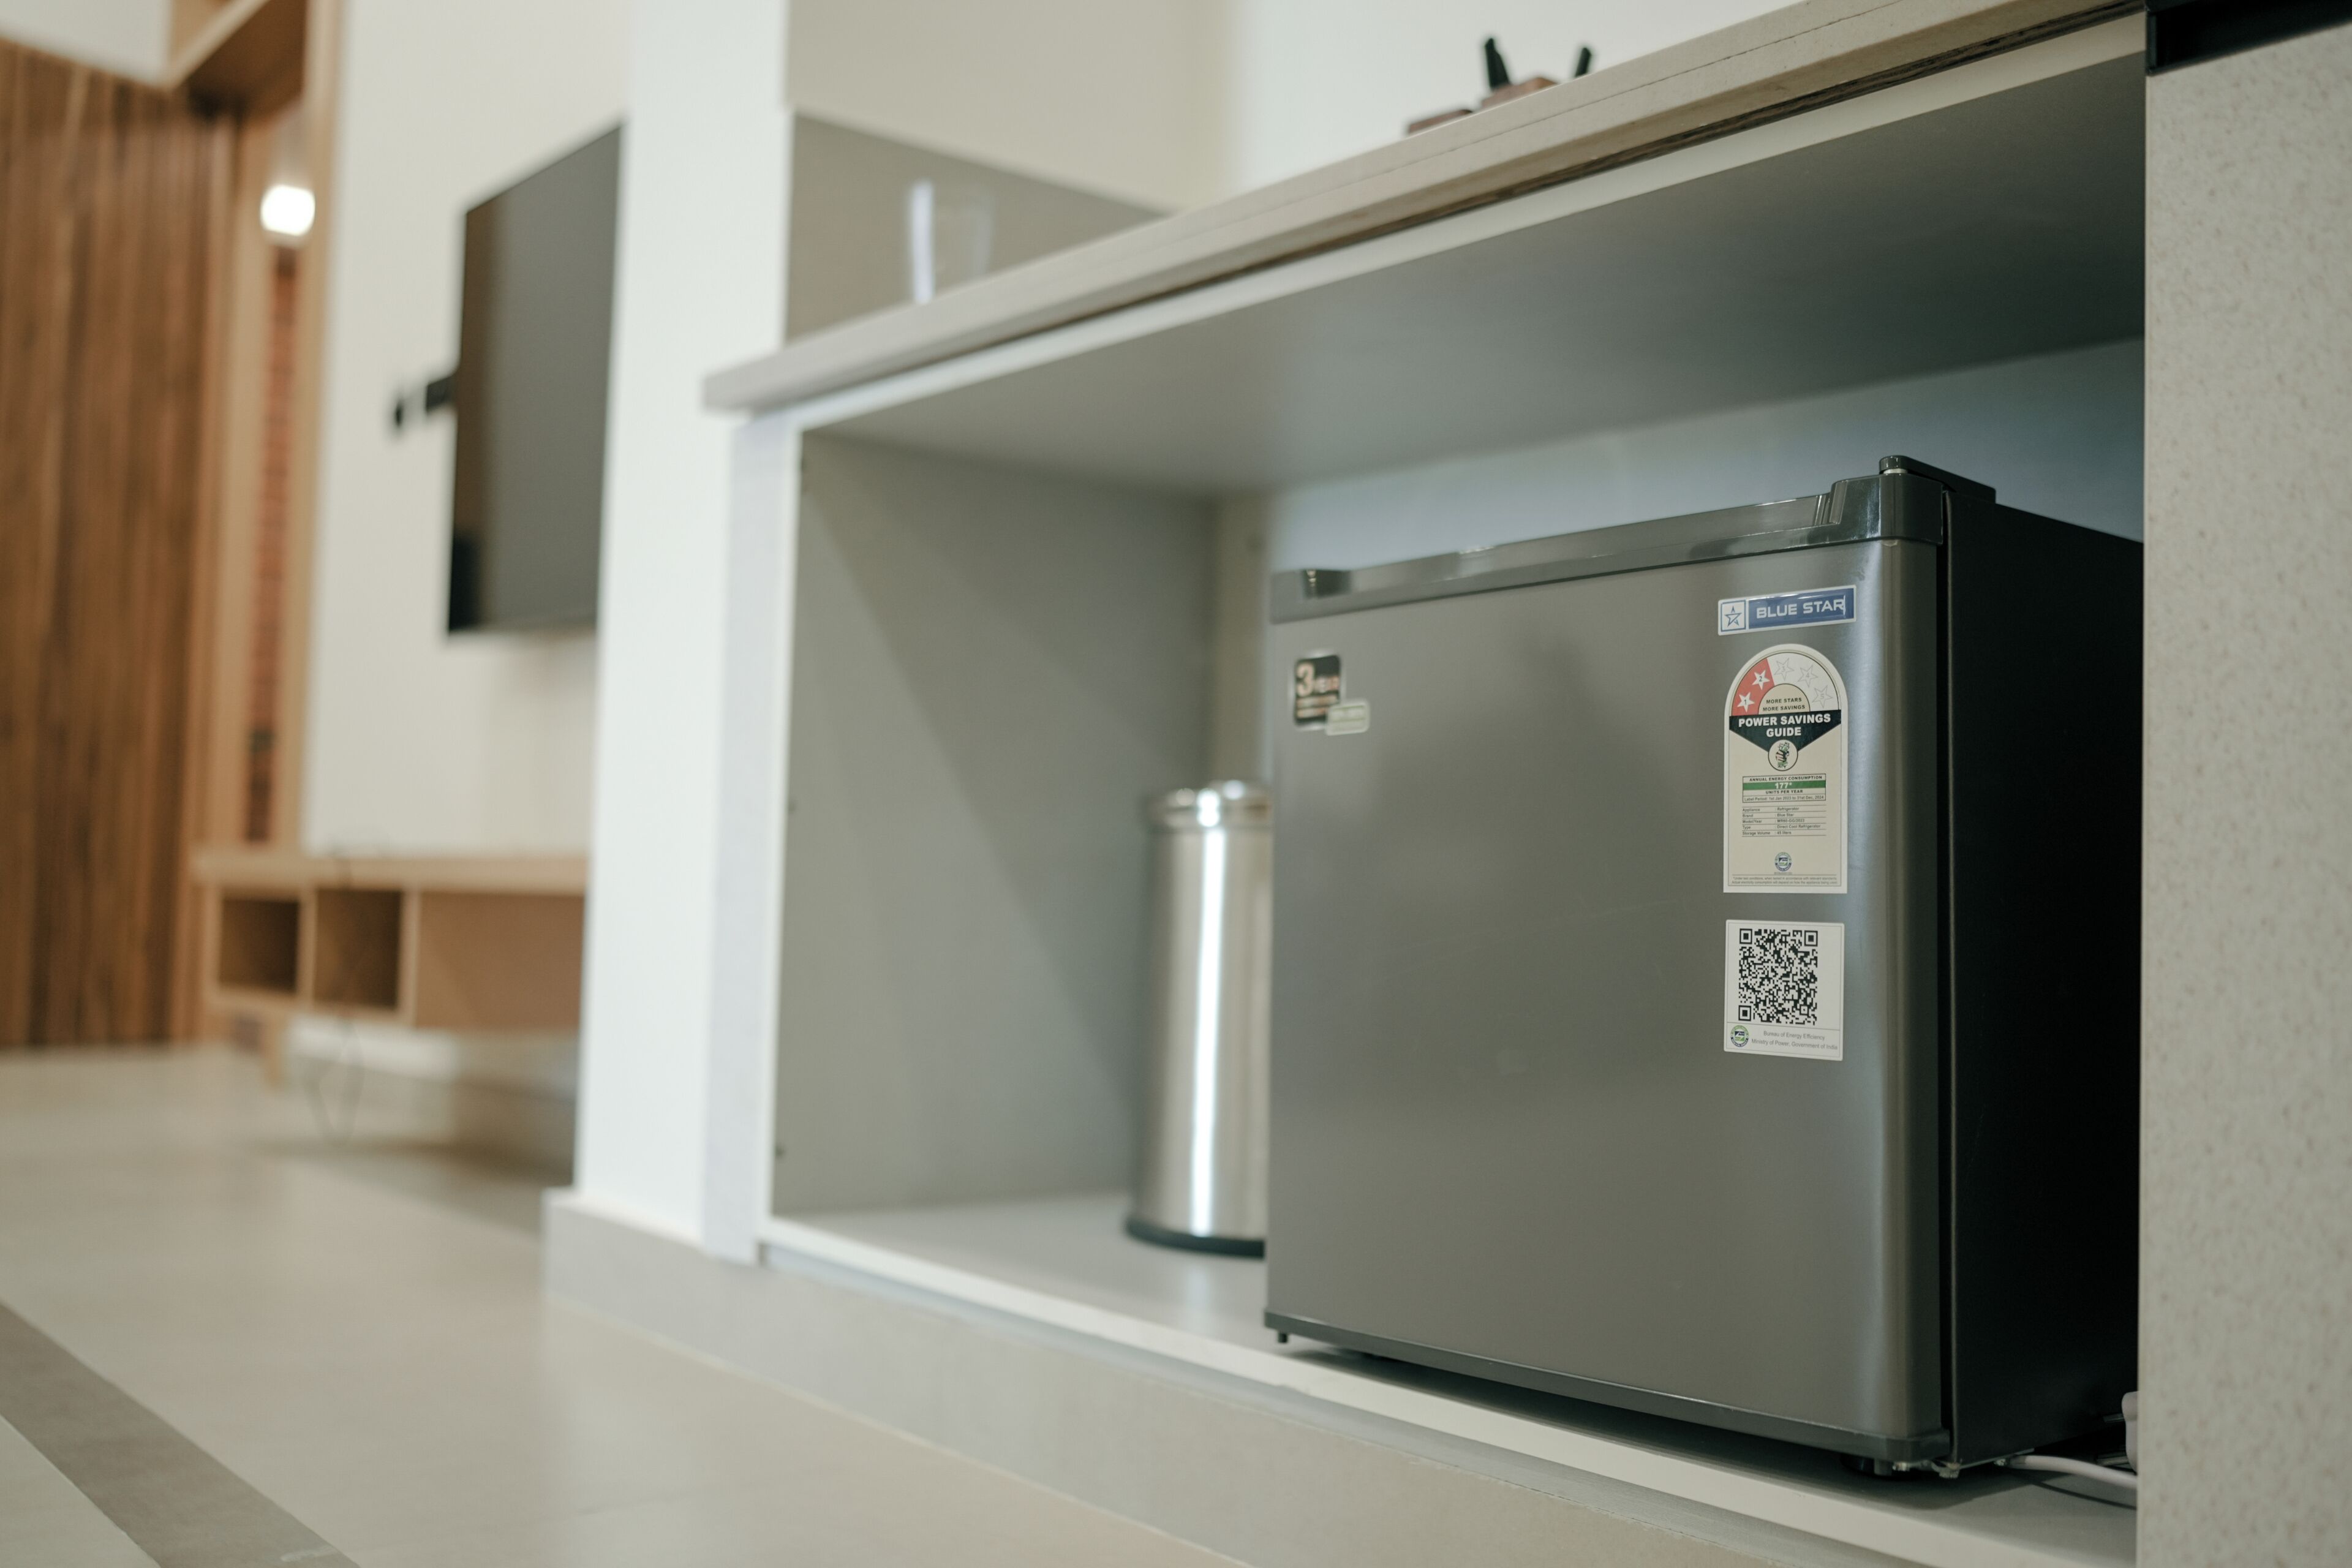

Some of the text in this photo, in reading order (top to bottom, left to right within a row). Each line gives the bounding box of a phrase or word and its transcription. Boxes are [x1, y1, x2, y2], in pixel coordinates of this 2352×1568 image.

[1757, 599, 1845, 619] BLUE STAR
[1296, 663, 1315, 697] 3
[1738, 713, 1831, 728] POWER SAVINGS
[1766, 726, 1802, 737] GUIDE
[1791, 1041, 1820, 1049] Government
